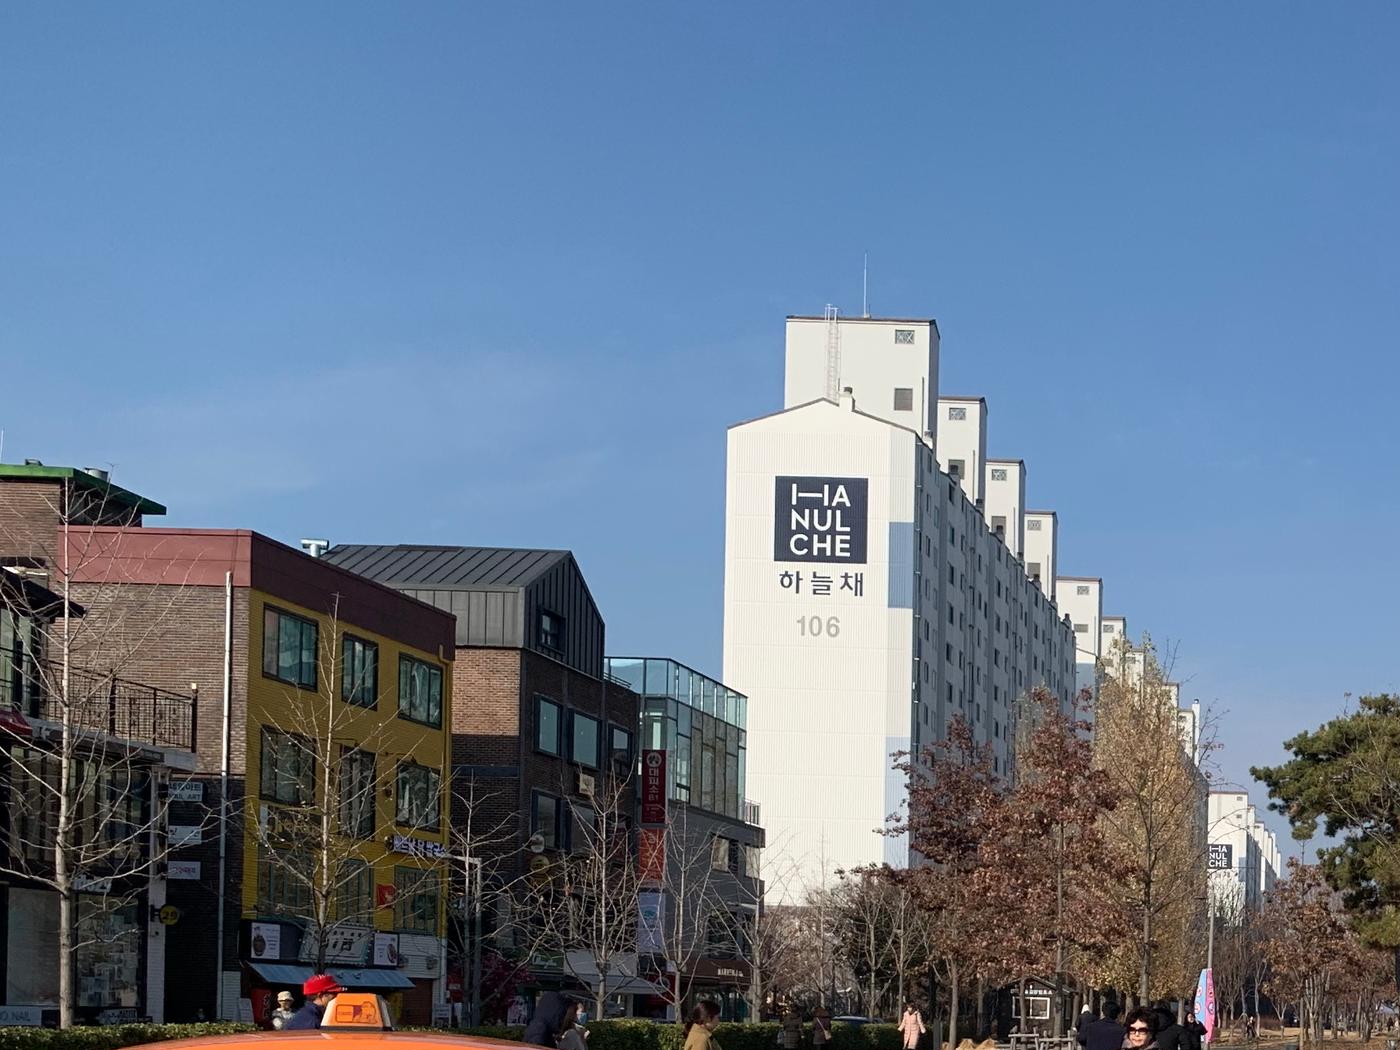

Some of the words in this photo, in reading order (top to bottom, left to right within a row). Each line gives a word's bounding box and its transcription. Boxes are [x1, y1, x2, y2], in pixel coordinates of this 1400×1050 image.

[791, 508, 851, 532] NUL
[789, 534, 851, 557] CHE
[779, 571, 864, 597] 하늘채
[796, 615, 841, 638] 106
